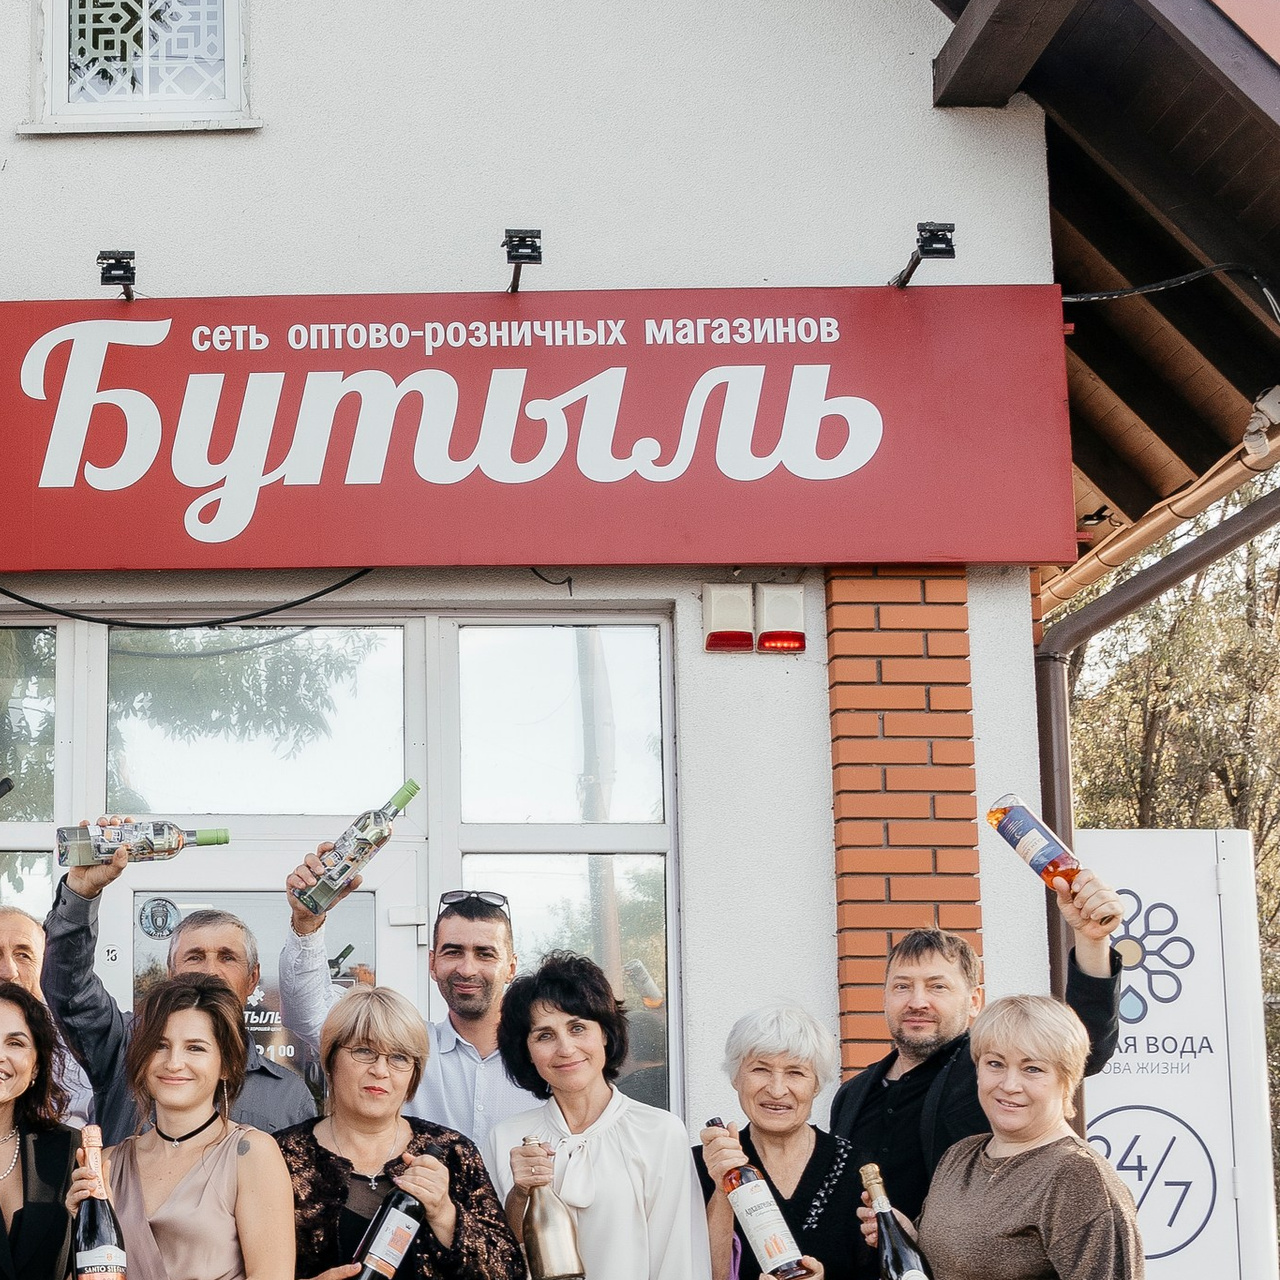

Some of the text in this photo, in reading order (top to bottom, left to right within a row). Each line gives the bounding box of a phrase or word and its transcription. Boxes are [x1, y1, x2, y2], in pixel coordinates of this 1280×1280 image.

[191, 316, 840, 356] сеть оптово-розничных магазинов
[20, 318, 883, 543] Бутыль
[243, 1011, 282, 1024] ТЫЛЬ
[1146, 1035, 1214, 1059] ВОДА
[1102, 1062, 1190, 1075] ОВА ЖИЗНИ
[84, 1265, 107, 1274] SANTO
